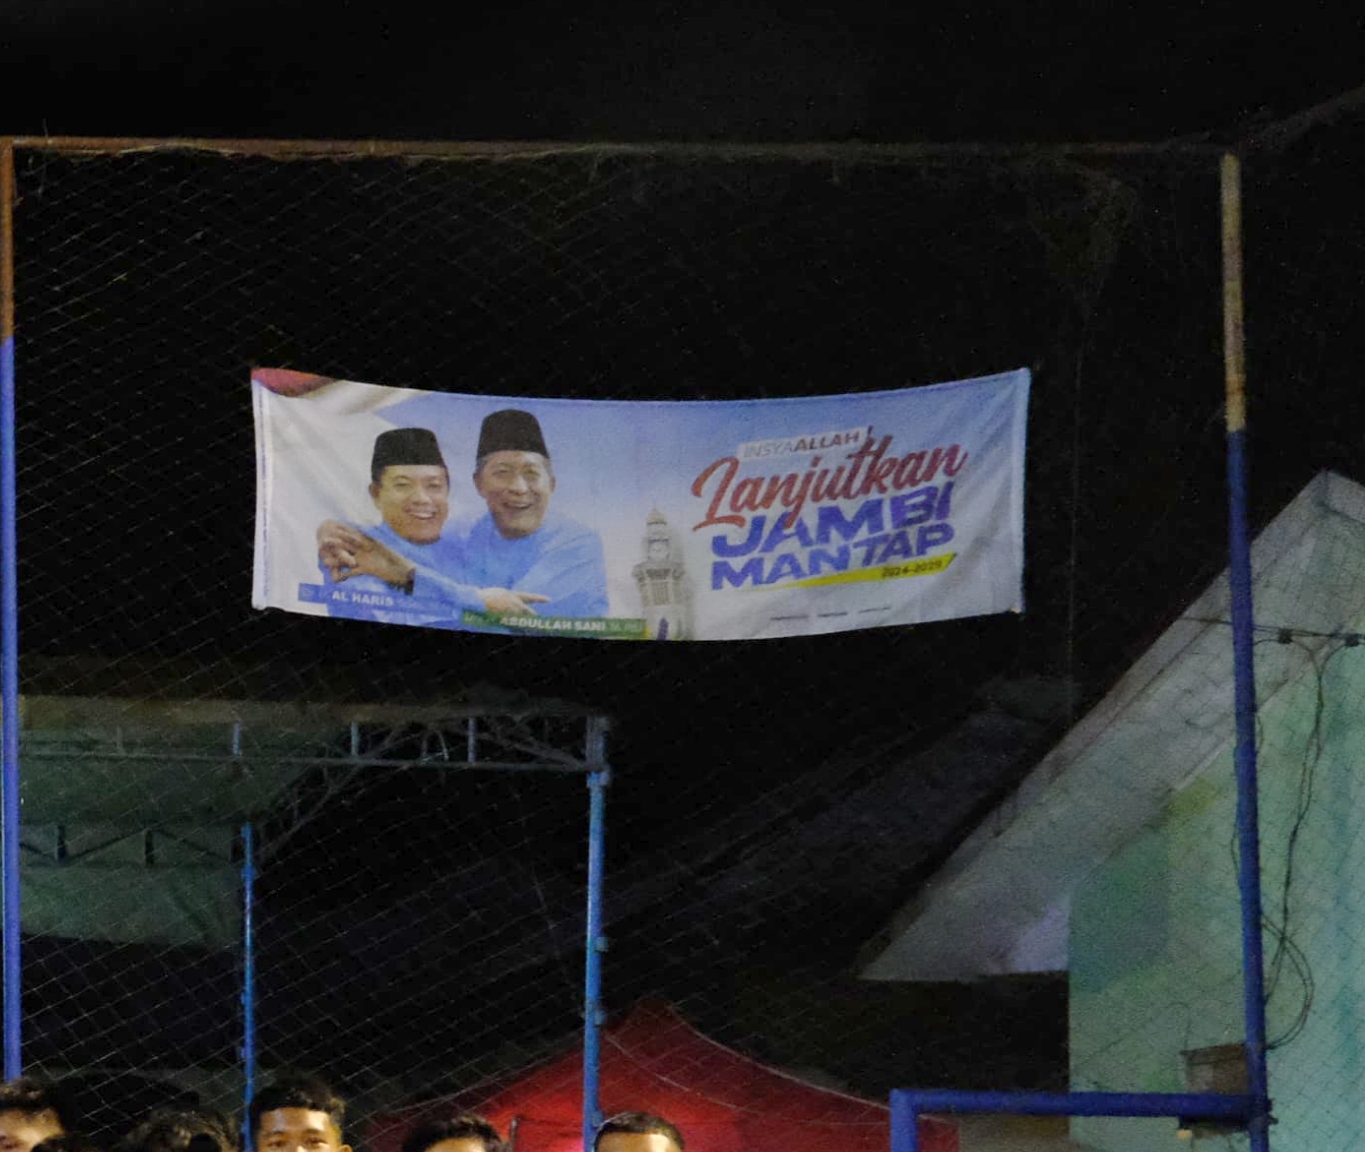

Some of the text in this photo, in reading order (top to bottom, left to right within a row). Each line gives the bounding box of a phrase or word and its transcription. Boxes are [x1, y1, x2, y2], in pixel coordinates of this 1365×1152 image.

[691, 425, 969, 532] Lanjutkan
[711, 481, 955, 558] JAMBI
[711, 521, 955, 591] MANTAP
[332, 590, 349, 602] AL
[352, 592, 395, 607] HARIS
[499, 615, 571, 631] ABDULLAH
[574, 621, 607, 632] SANI
